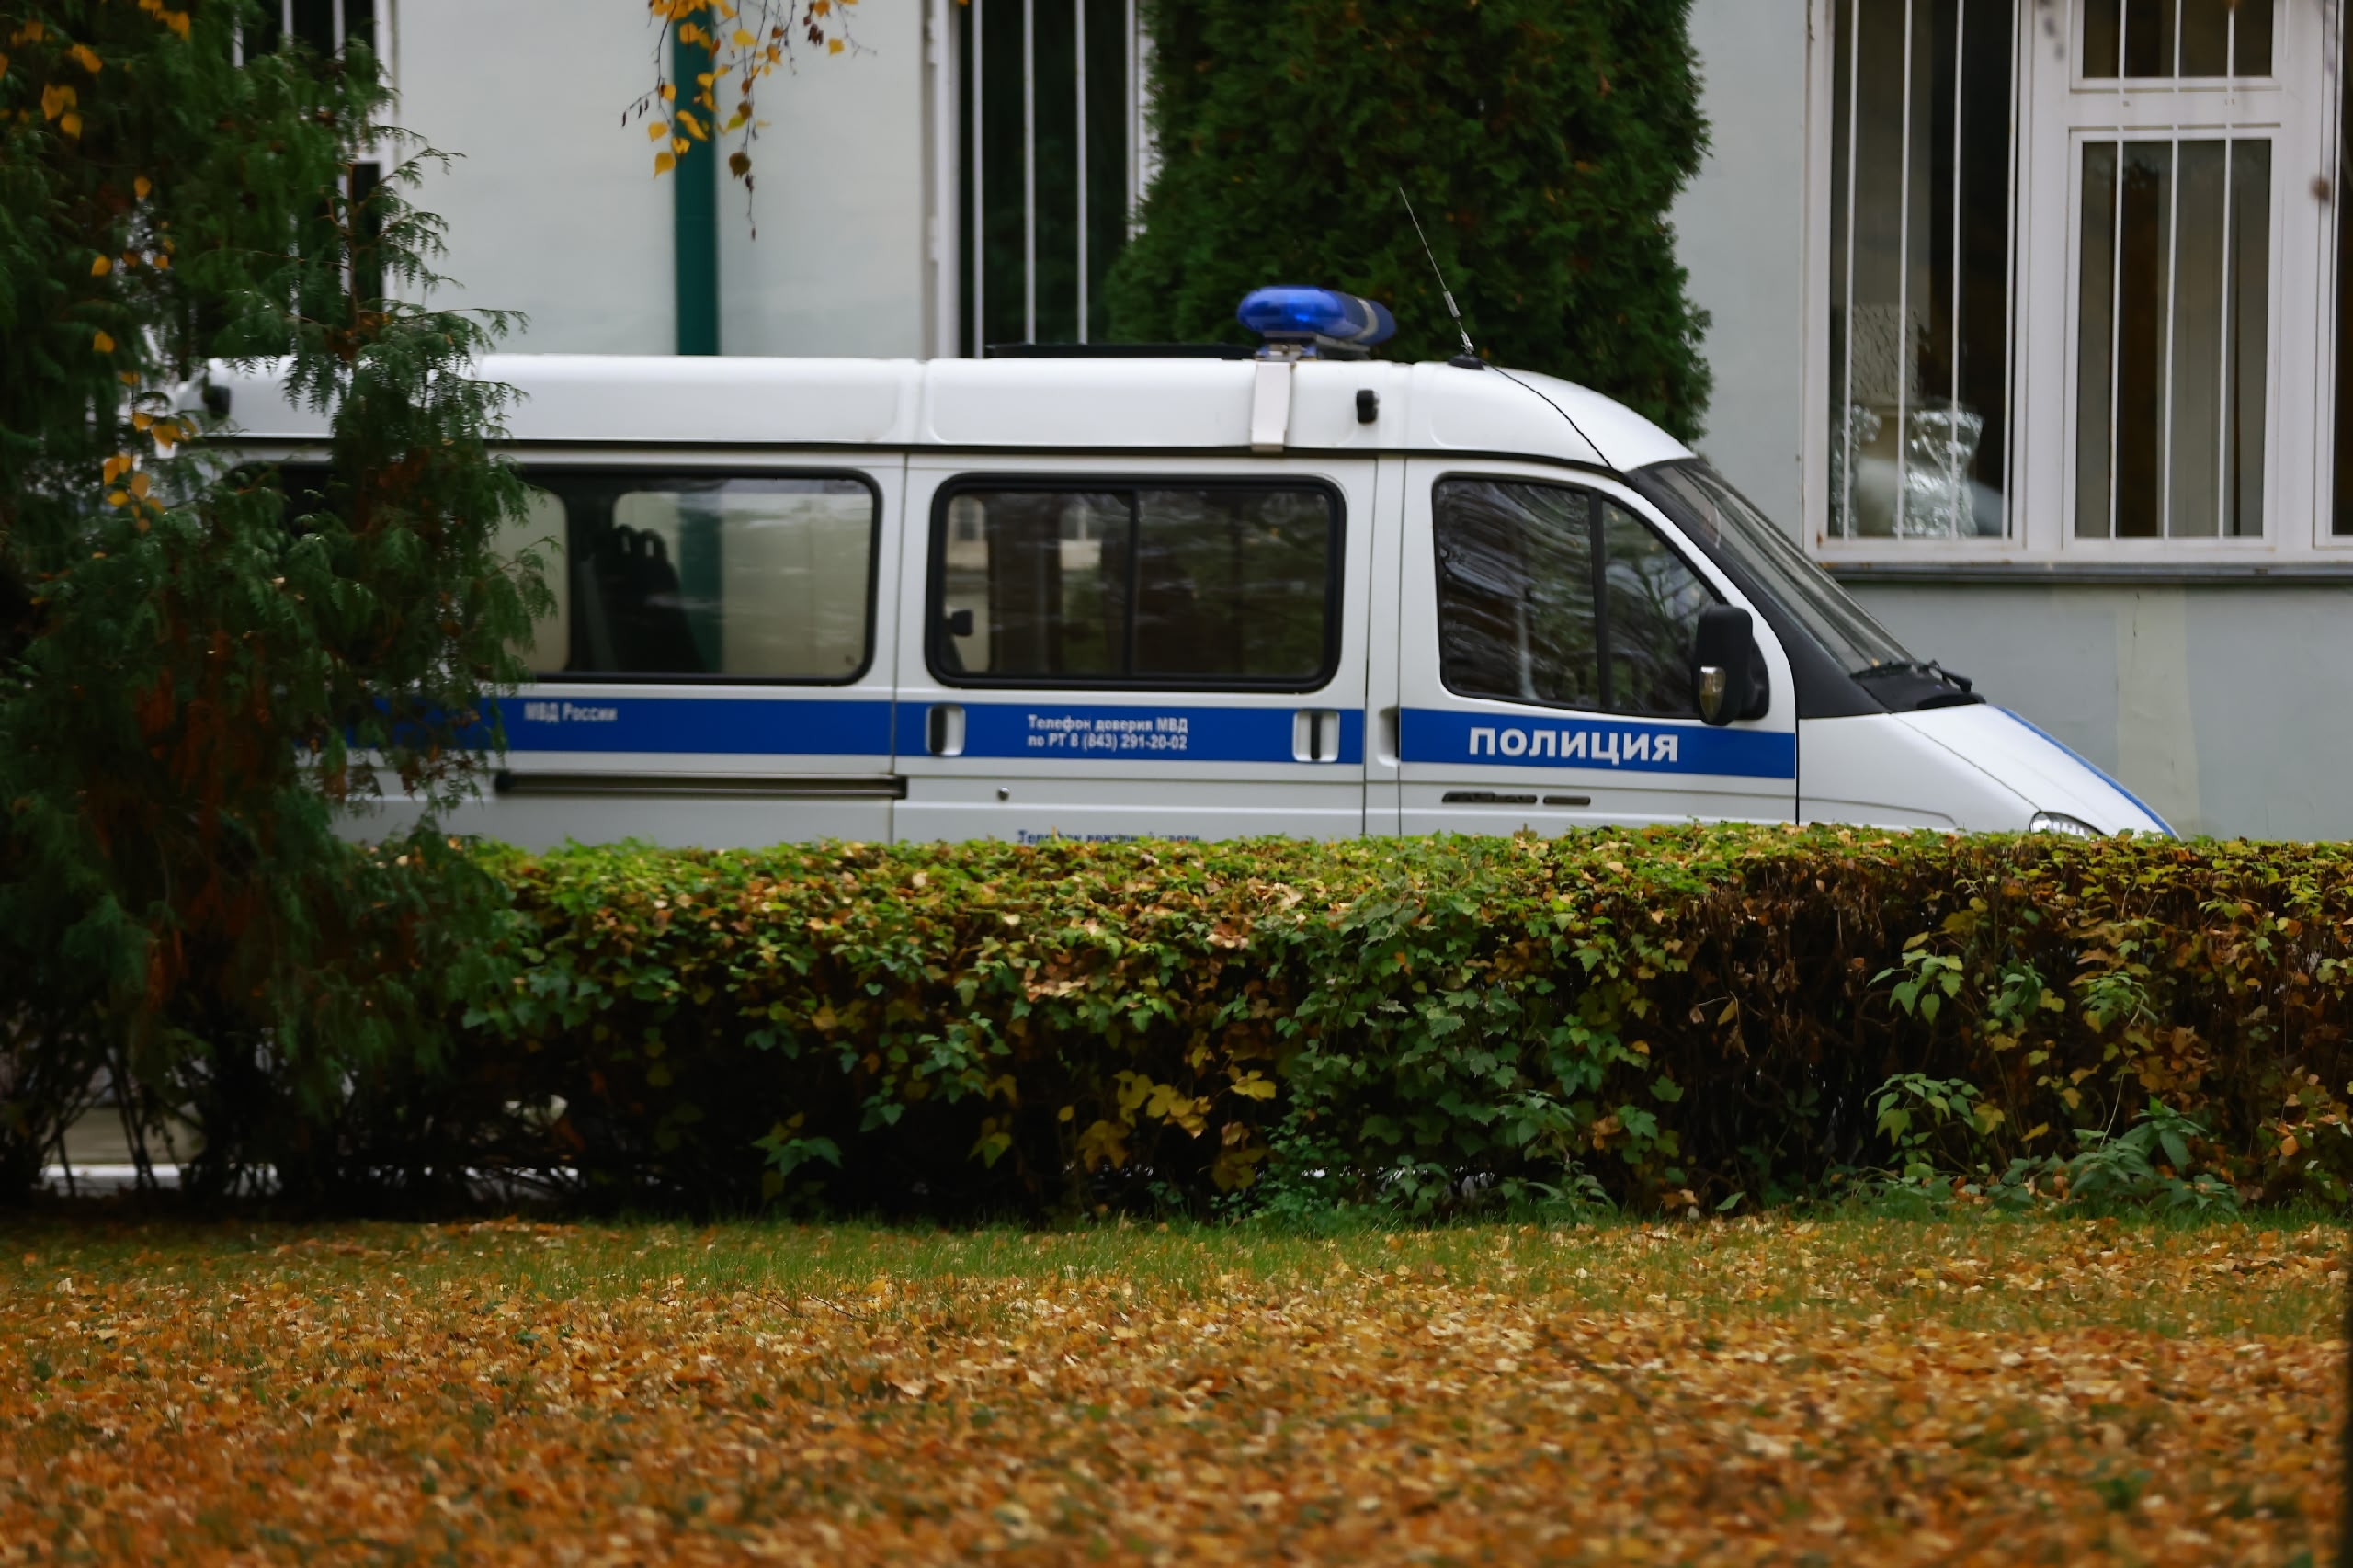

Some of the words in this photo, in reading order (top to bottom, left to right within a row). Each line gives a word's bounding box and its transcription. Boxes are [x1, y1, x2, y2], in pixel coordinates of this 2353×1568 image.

[523, 701, 559, 723] МВД
[563, 701, 617, 721] России
[1027, 714, 1091, 733] Телефон
[1155, 717, 1188, 734] МВД
[1027, 734, 1045, 747] по
[1048, 733, 1067, 747] РТ
[1082, 733, 1118, 752] (843)
[1120, 735, 1188, 751] 291-20-02
[1469, 727, 1679, 765] ПОЛИЦИЯ
